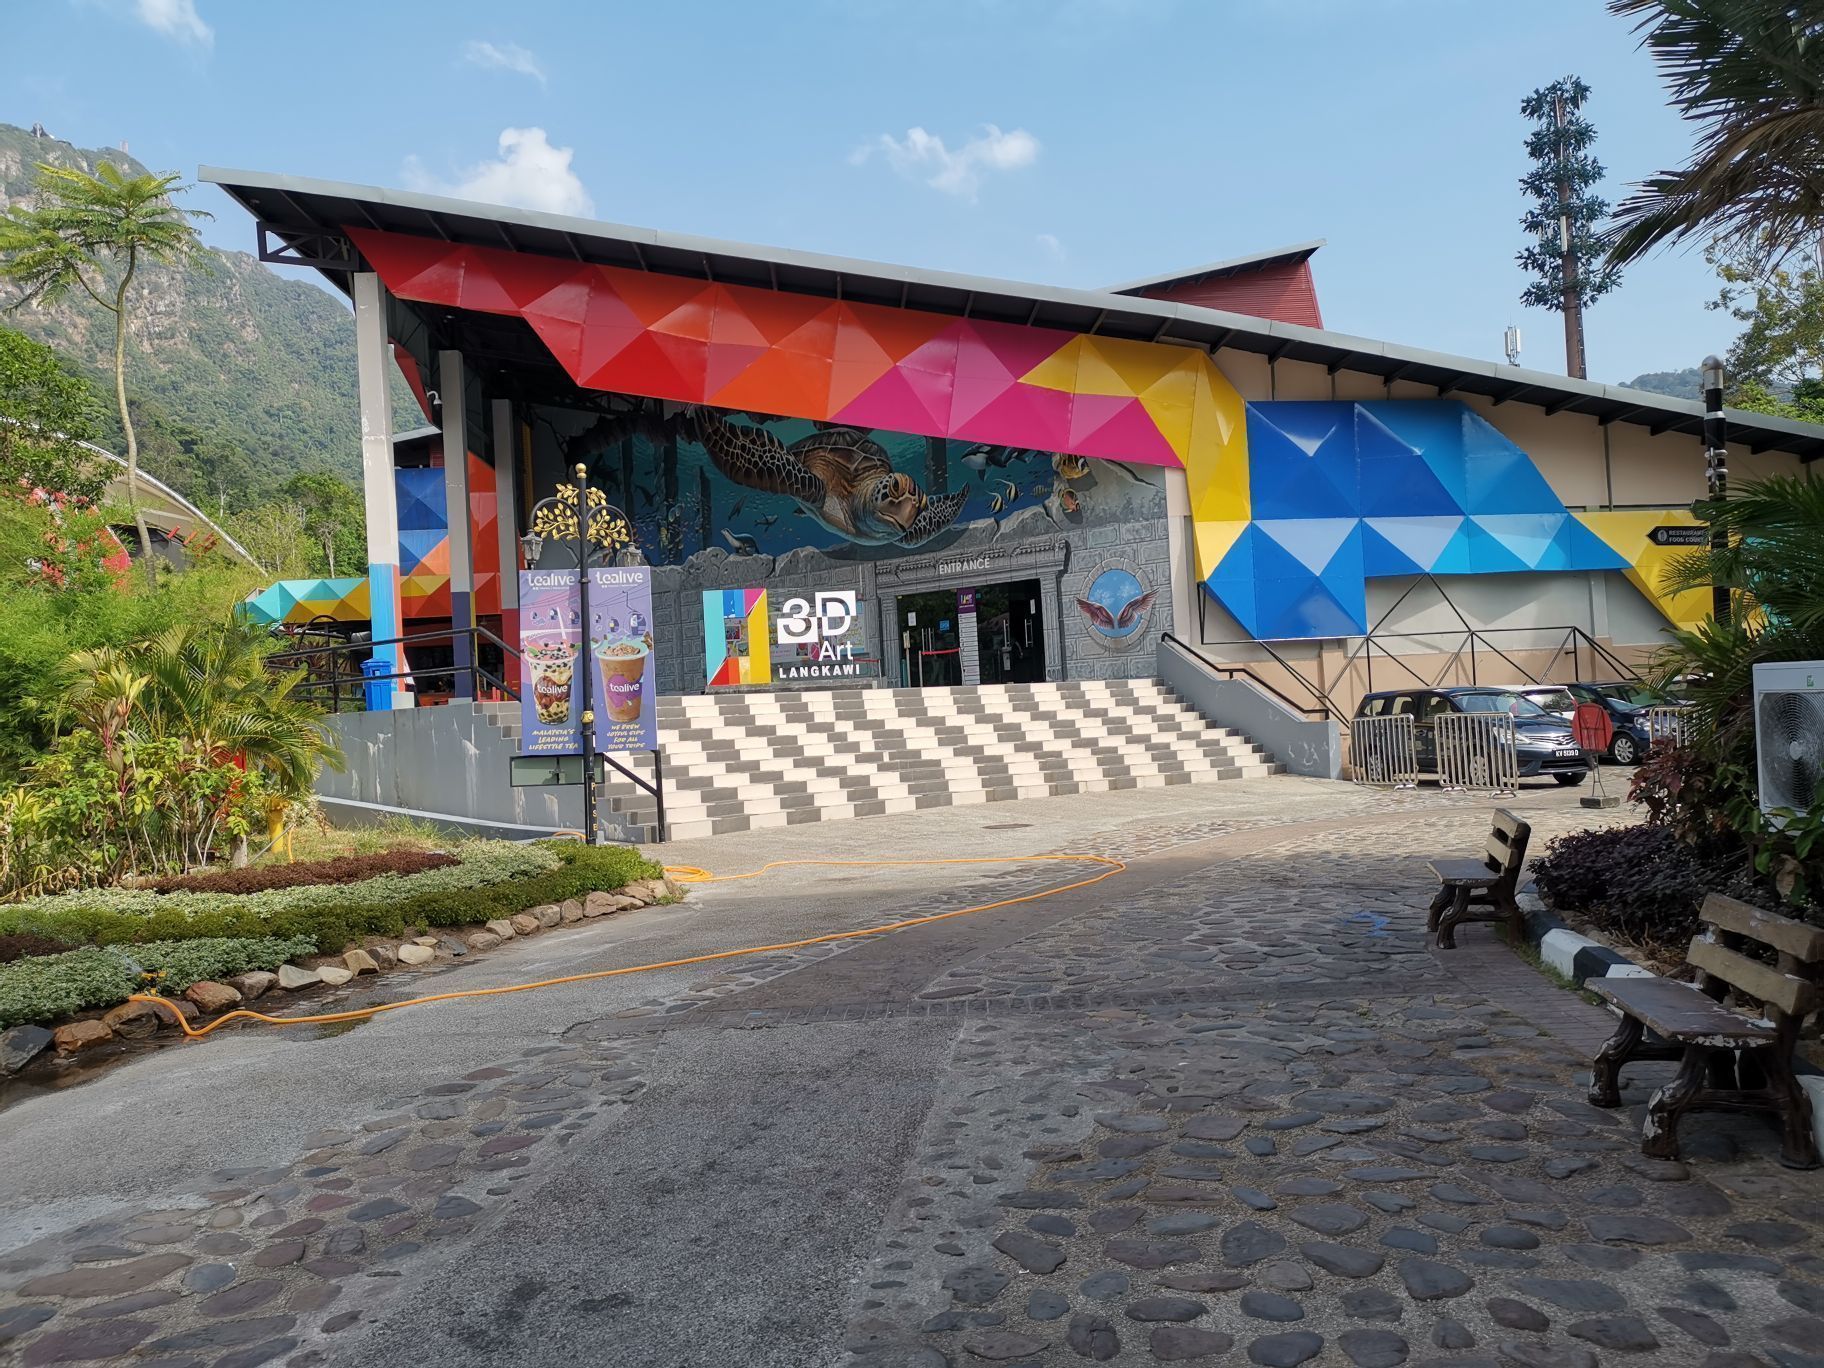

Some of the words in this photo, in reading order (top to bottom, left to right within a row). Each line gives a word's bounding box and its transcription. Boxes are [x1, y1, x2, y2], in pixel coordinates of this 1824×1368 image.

[939, 558, 991, 575] ENTRANCE
[528, 573, 575, 586] tealive
[595, 570, 643, 584] tealive
[780, 595, 853, 639] 3D
[818, 640, 854, 662] Art
[778, 664, 860, 679] LANGKAWI
[537, 684, 568, 694] tealive
[609, 683, 640, 692] tealive
[538, 735, 569, 743] LEADING
